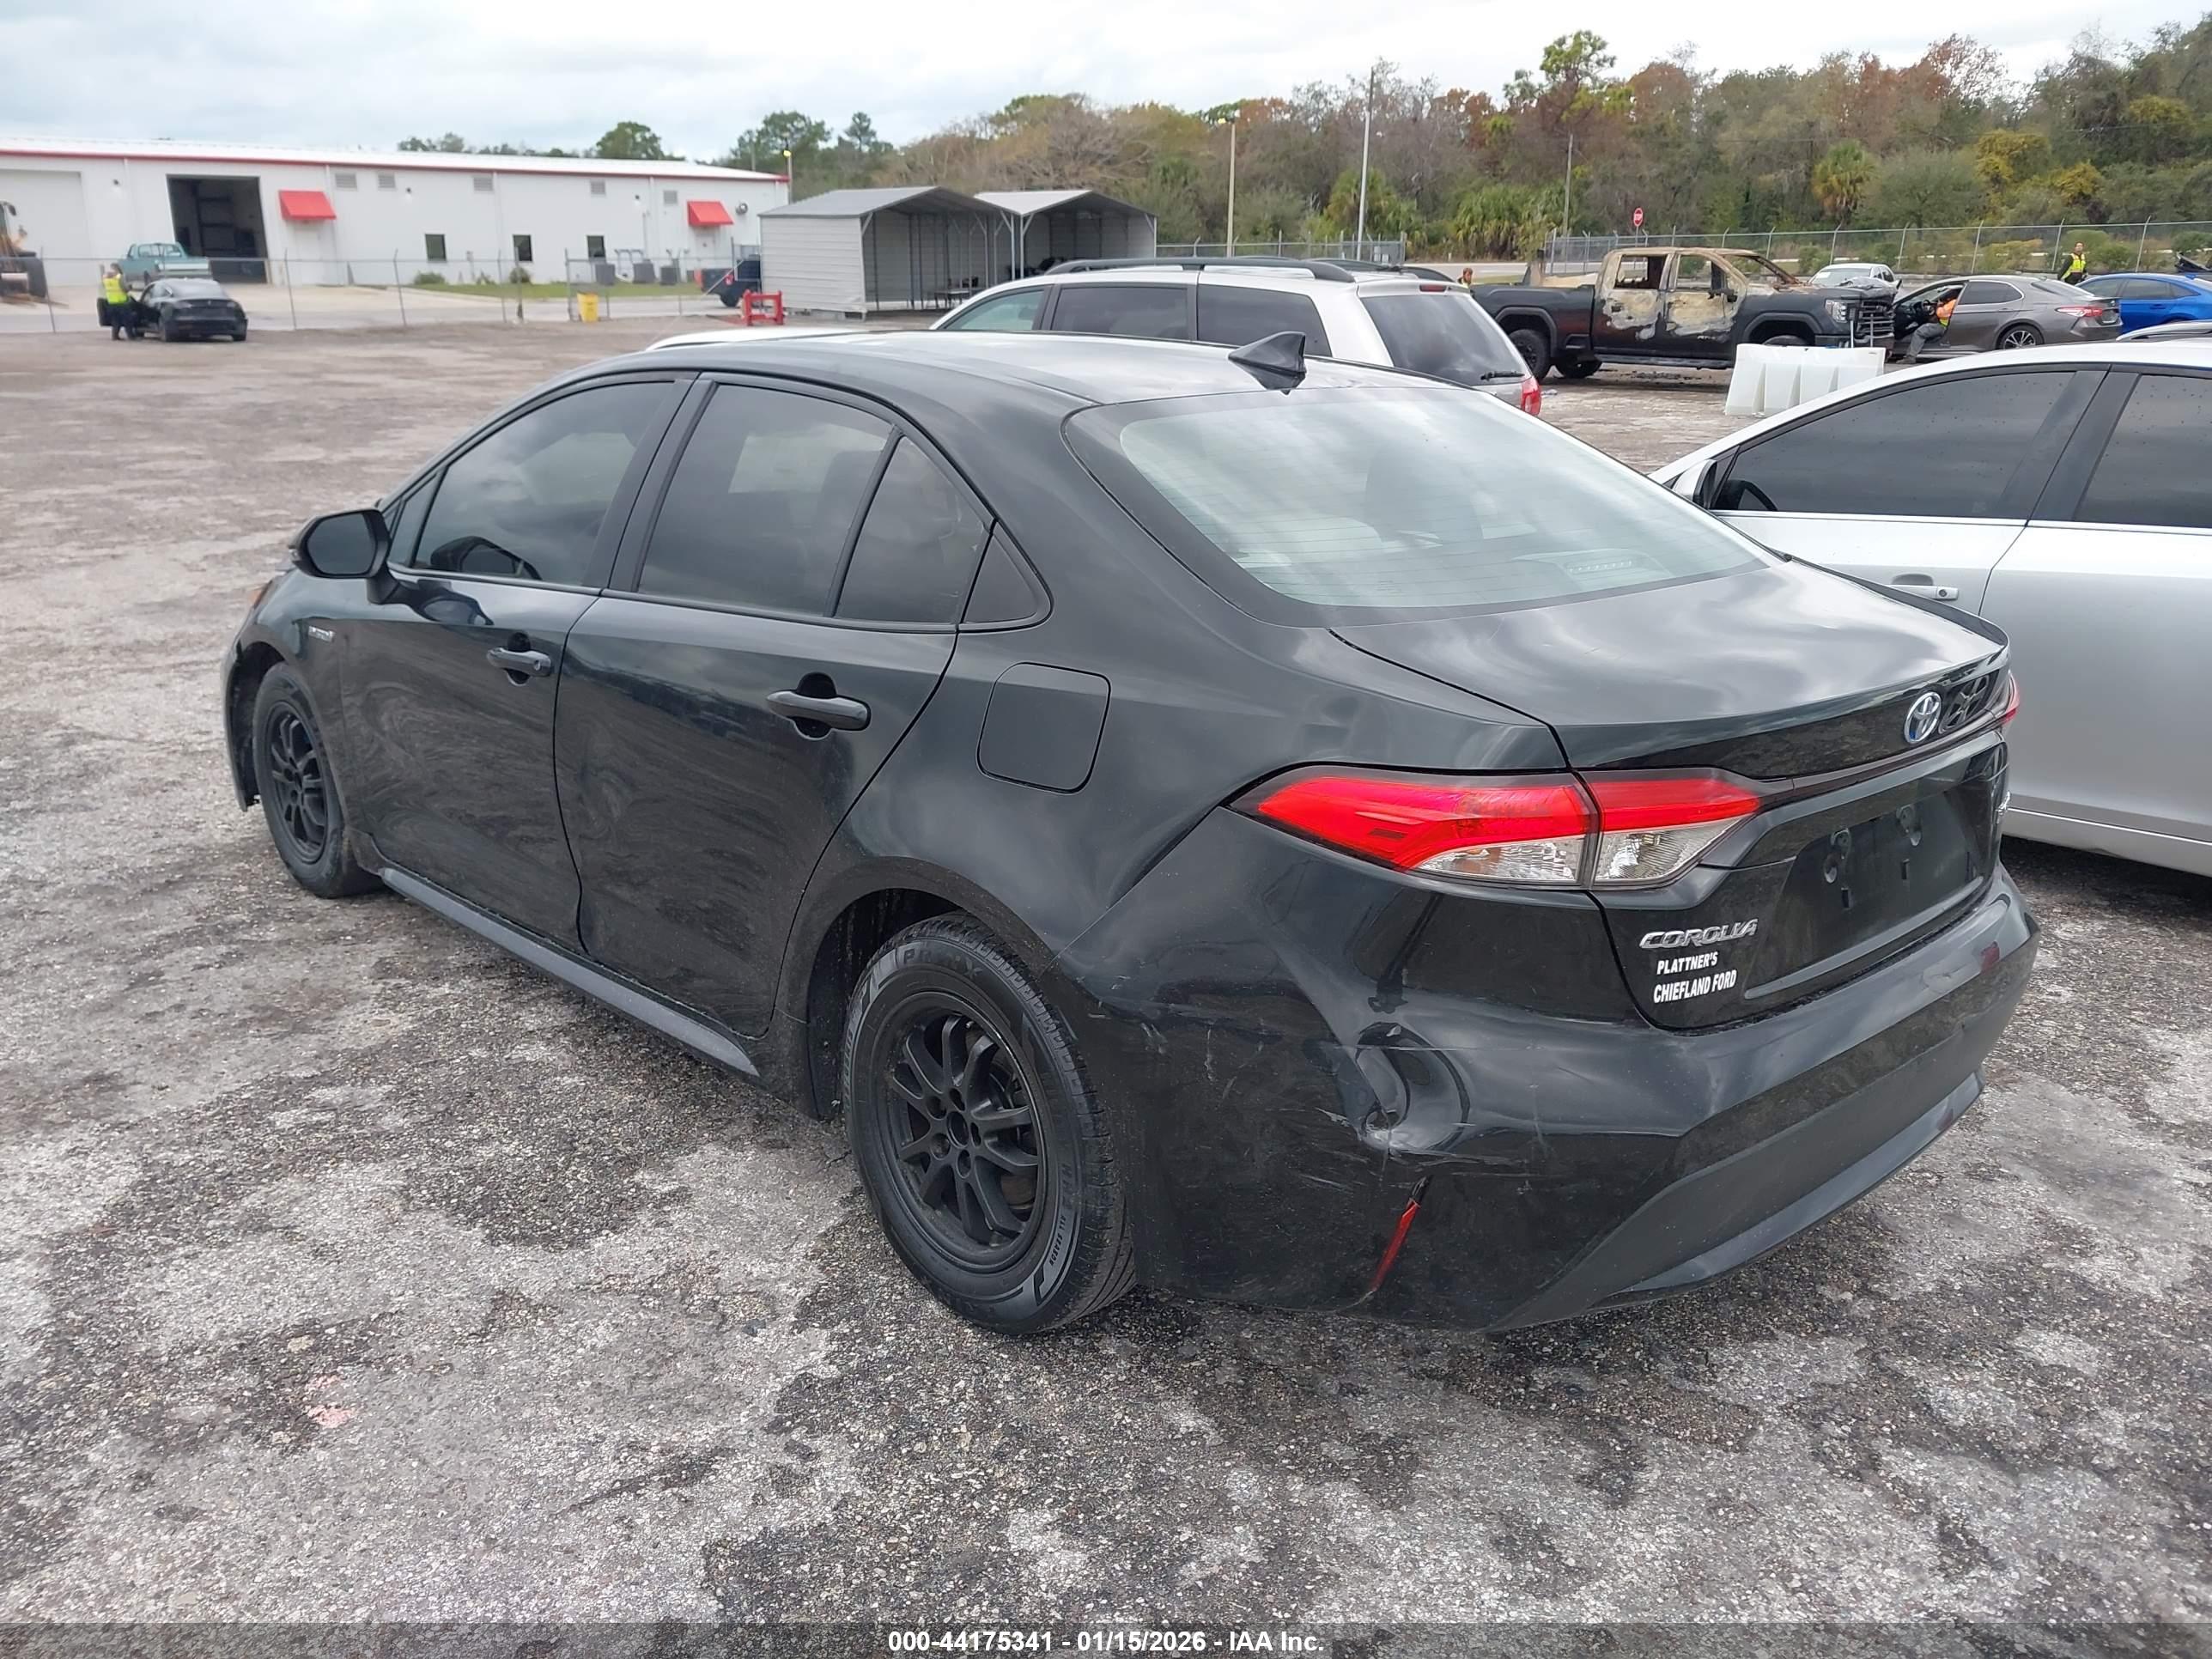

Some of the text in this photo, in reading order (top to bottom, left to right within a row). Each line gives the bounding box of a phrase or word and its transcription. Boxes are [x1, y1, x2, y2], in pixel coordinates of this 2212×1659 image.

[1639, 918, 1759, 949] COROLLA
[1656, 951, 1719, 975] PLATTNER'S
[1653, 969, 1738, 1004] CHIEFLAND FORD
